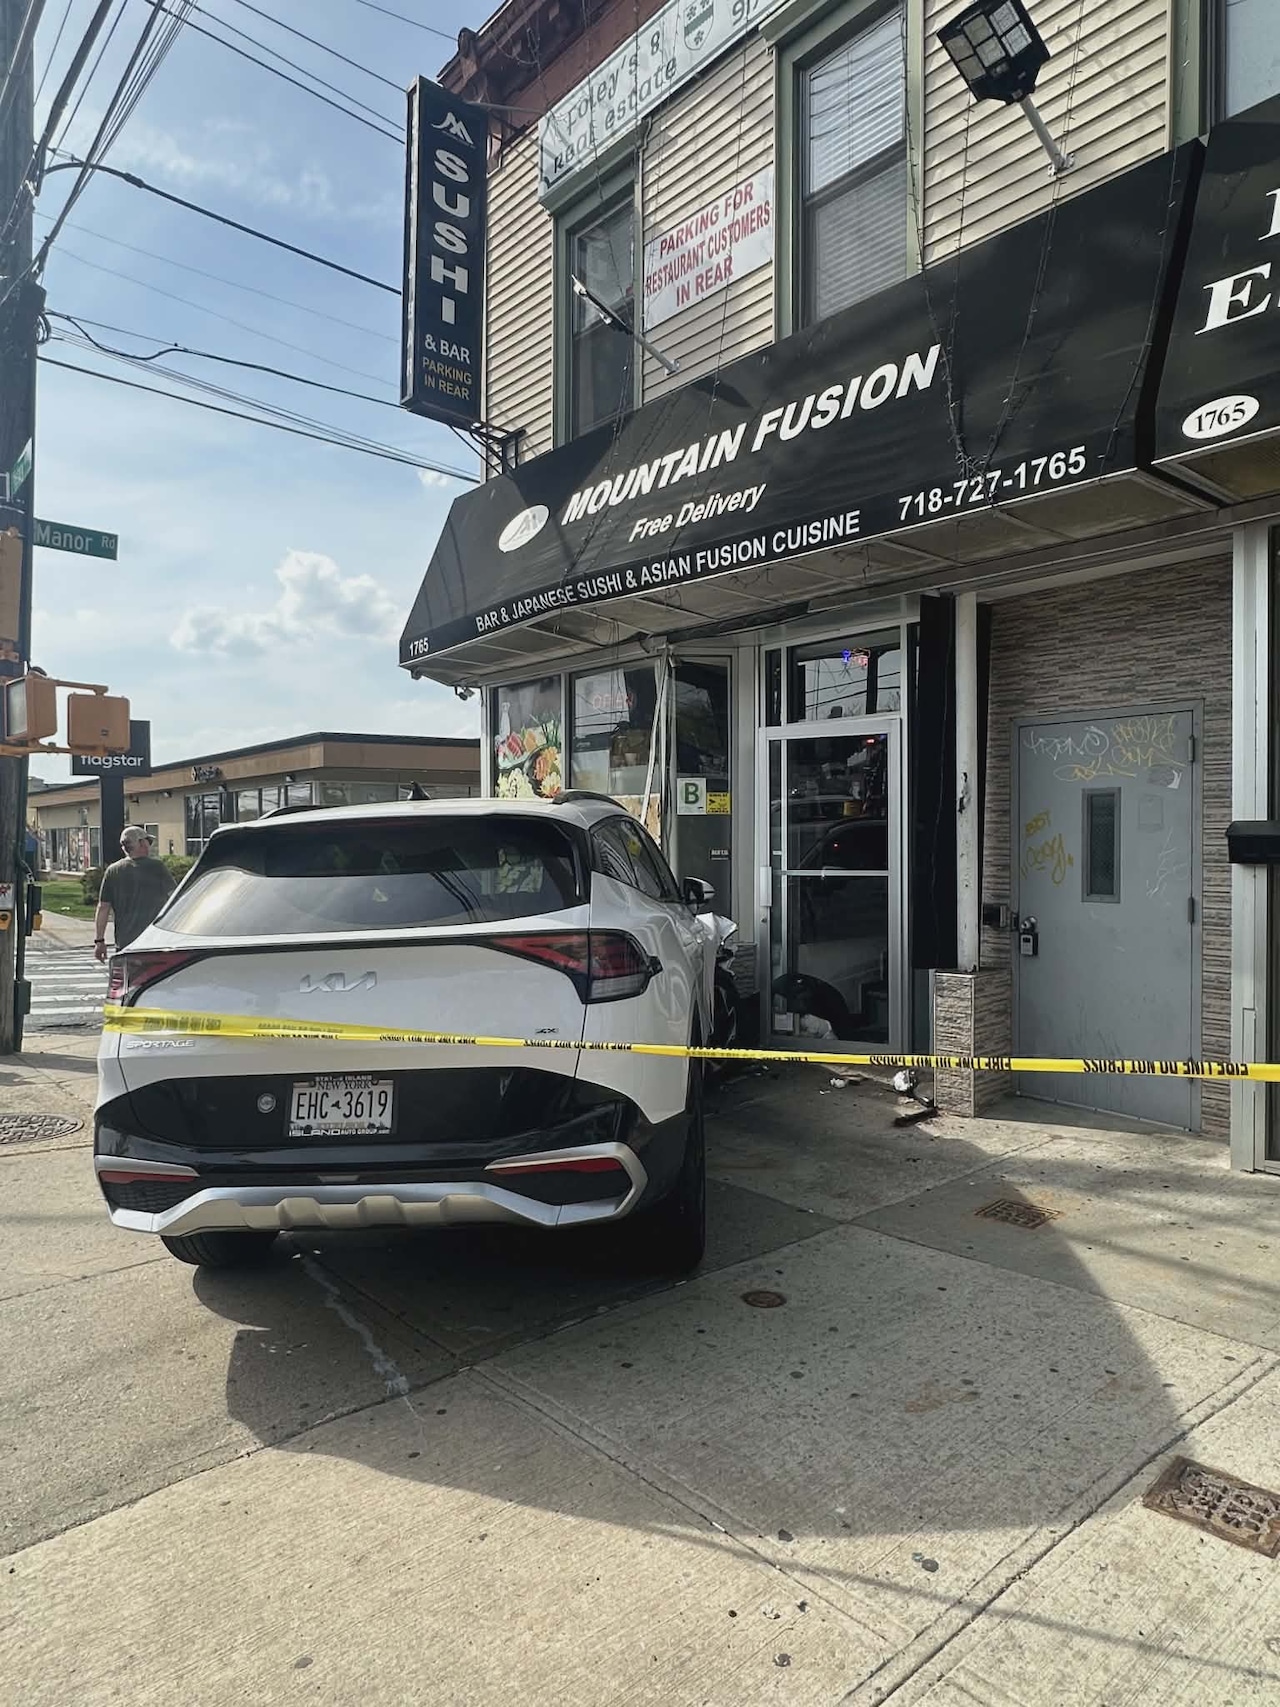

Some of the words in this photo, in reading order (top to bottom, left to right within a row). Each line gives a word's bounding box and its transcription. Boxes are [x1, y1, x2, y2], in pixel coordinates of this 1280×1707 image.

[660, 204, 719, 259] PARKING
[724, 181, 754, 217] FOR
[430, 149, 470, 325] SUSHI
[645, 241, 706, 298] RESTAURANT
[707, 200, 771, 259] CUSTOMERS
[676, 281, 690, 307] IN
[695, 255, 734, 296] REAR
[1194, 262, 1280, 335] E
[425, 334, 437, 352] &
[440, 339, 470, 364] BAR
[422, 356, 472, 385] PARKING
[424, 373, 436, 389] IN
[438, 379, 470, 401] REAR
[1195, 401, 1246, 434] 1765
[561, 422, 747, 526] MOUNTAIN
[751, 343, 941, 453] FUSION
[897, 446, 1087, 522] 718-727-1765
[628, 514, 673, 544] Free
[675, 483, 767, 529] Delivery
[38, 523, 93, 551] Manor
[101, 535, 115, 549] Rd
[476, 613, 500, 634] BAR
[500, 606, 511, 624] &
[511, 584, 576, 620] JAPANESE
[577, 572, 623, 600] SUSHI
[625, 569, 638, 589] &
[640, 555, 692, 586] ASIAN
[696, 536, 766, 573] FUSION
[772, 510, 861, 554] CUISINE
[409, 637, 429, 657] 1765
[80, 754, 144, 769] flagstar
[684, 782, 699, 805] B
[126, 1039, 196, 1050] SPORTAGE
[1082, 1058, 1126, 1073] CROSS
[1129, 1059, 1156, 1074] NOT
[1158, 1060, 1179, 1075] DO
[1183, 1061, 1213, 1075] LINE
[1217, 1062, 1249, 1076] FIRE
[316, 1079, 340, 1090] NEW
[343, 1079, 372, 1090] YORK
[296, 1091, 329, 1120] EHC
[343, 1090, 388, 1118] 3619
